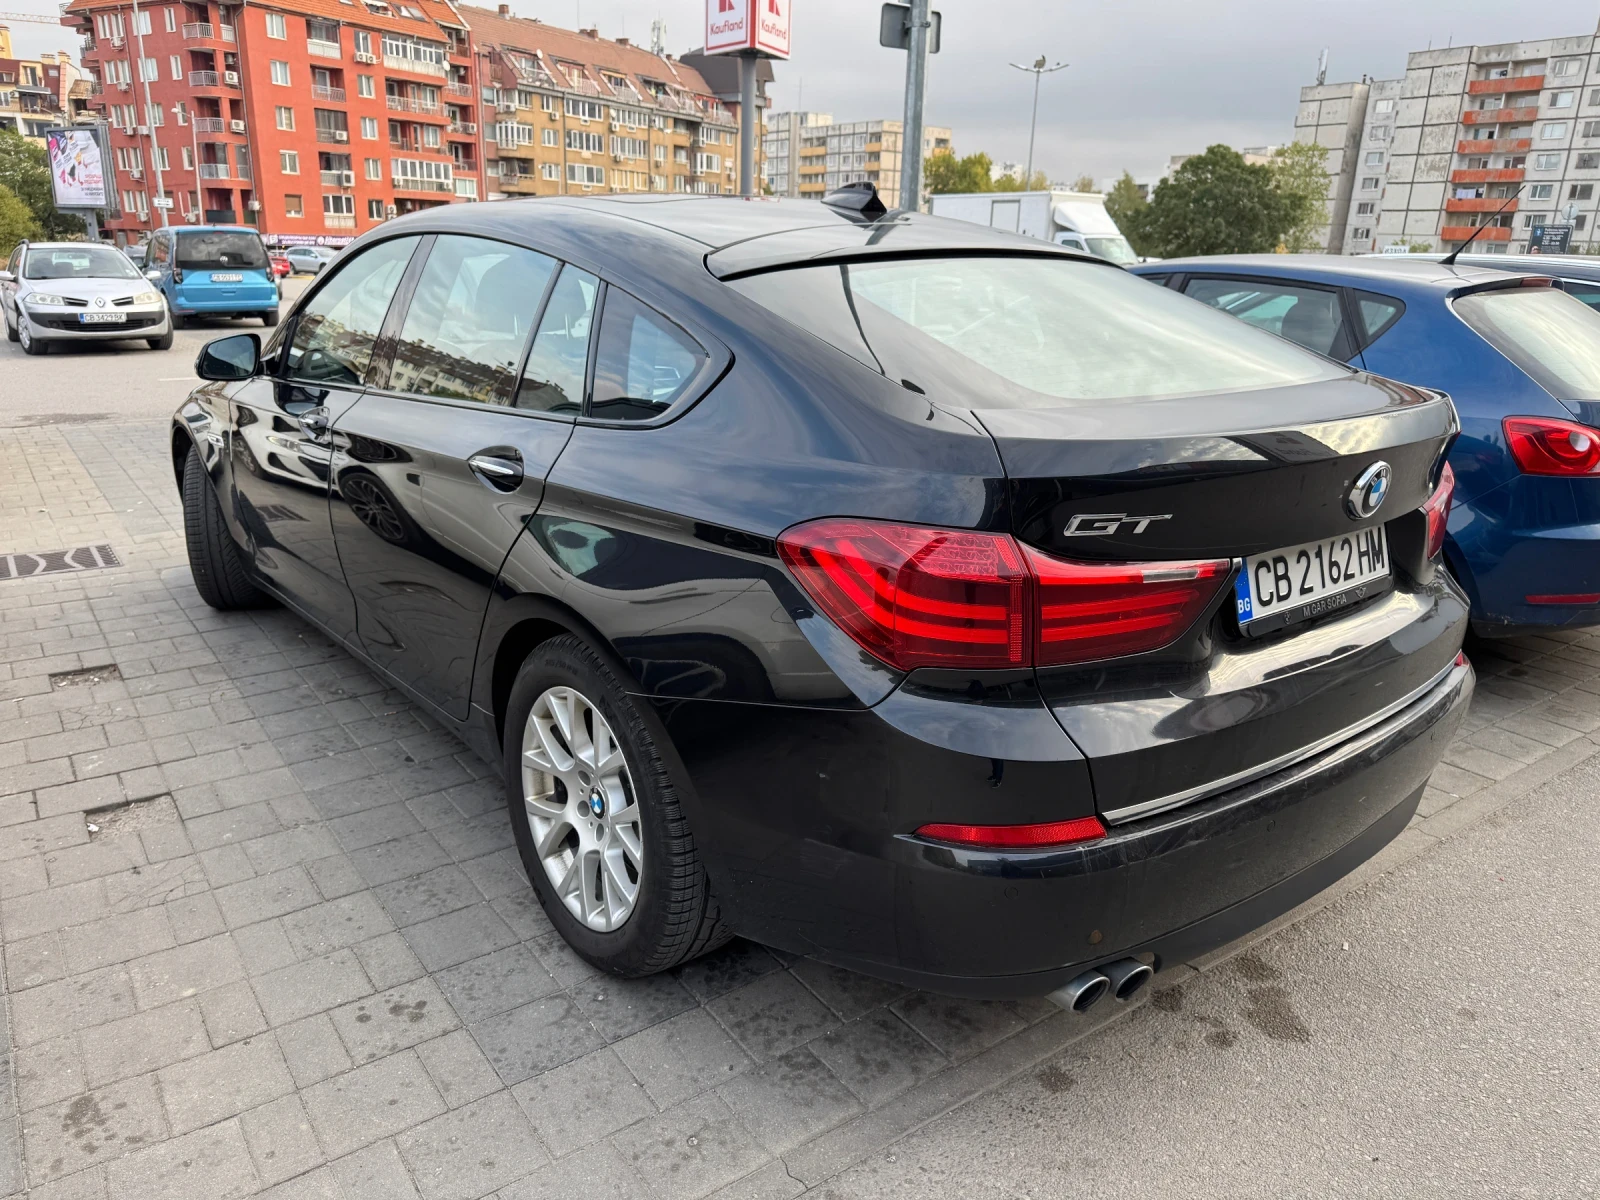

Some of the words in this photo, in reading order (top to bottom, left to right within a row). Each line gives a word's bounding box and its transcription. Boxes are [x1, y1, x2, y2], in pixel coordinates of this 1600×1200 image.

[710, 17, 744, 36] Kaufland
[761, 18, 787, 40] Kaufland
[1063, 513, 1173, 537] GT
[1254, 555, 1293, 608] CB
[1296, 537, 1356, 596] 2162
[1356, 526, 1385, 576] HM
[1237, 598, 1251, 614] BG
[1303, 606, 1311, 617] M
[1327, 593, 1347, 609] SOFIA
